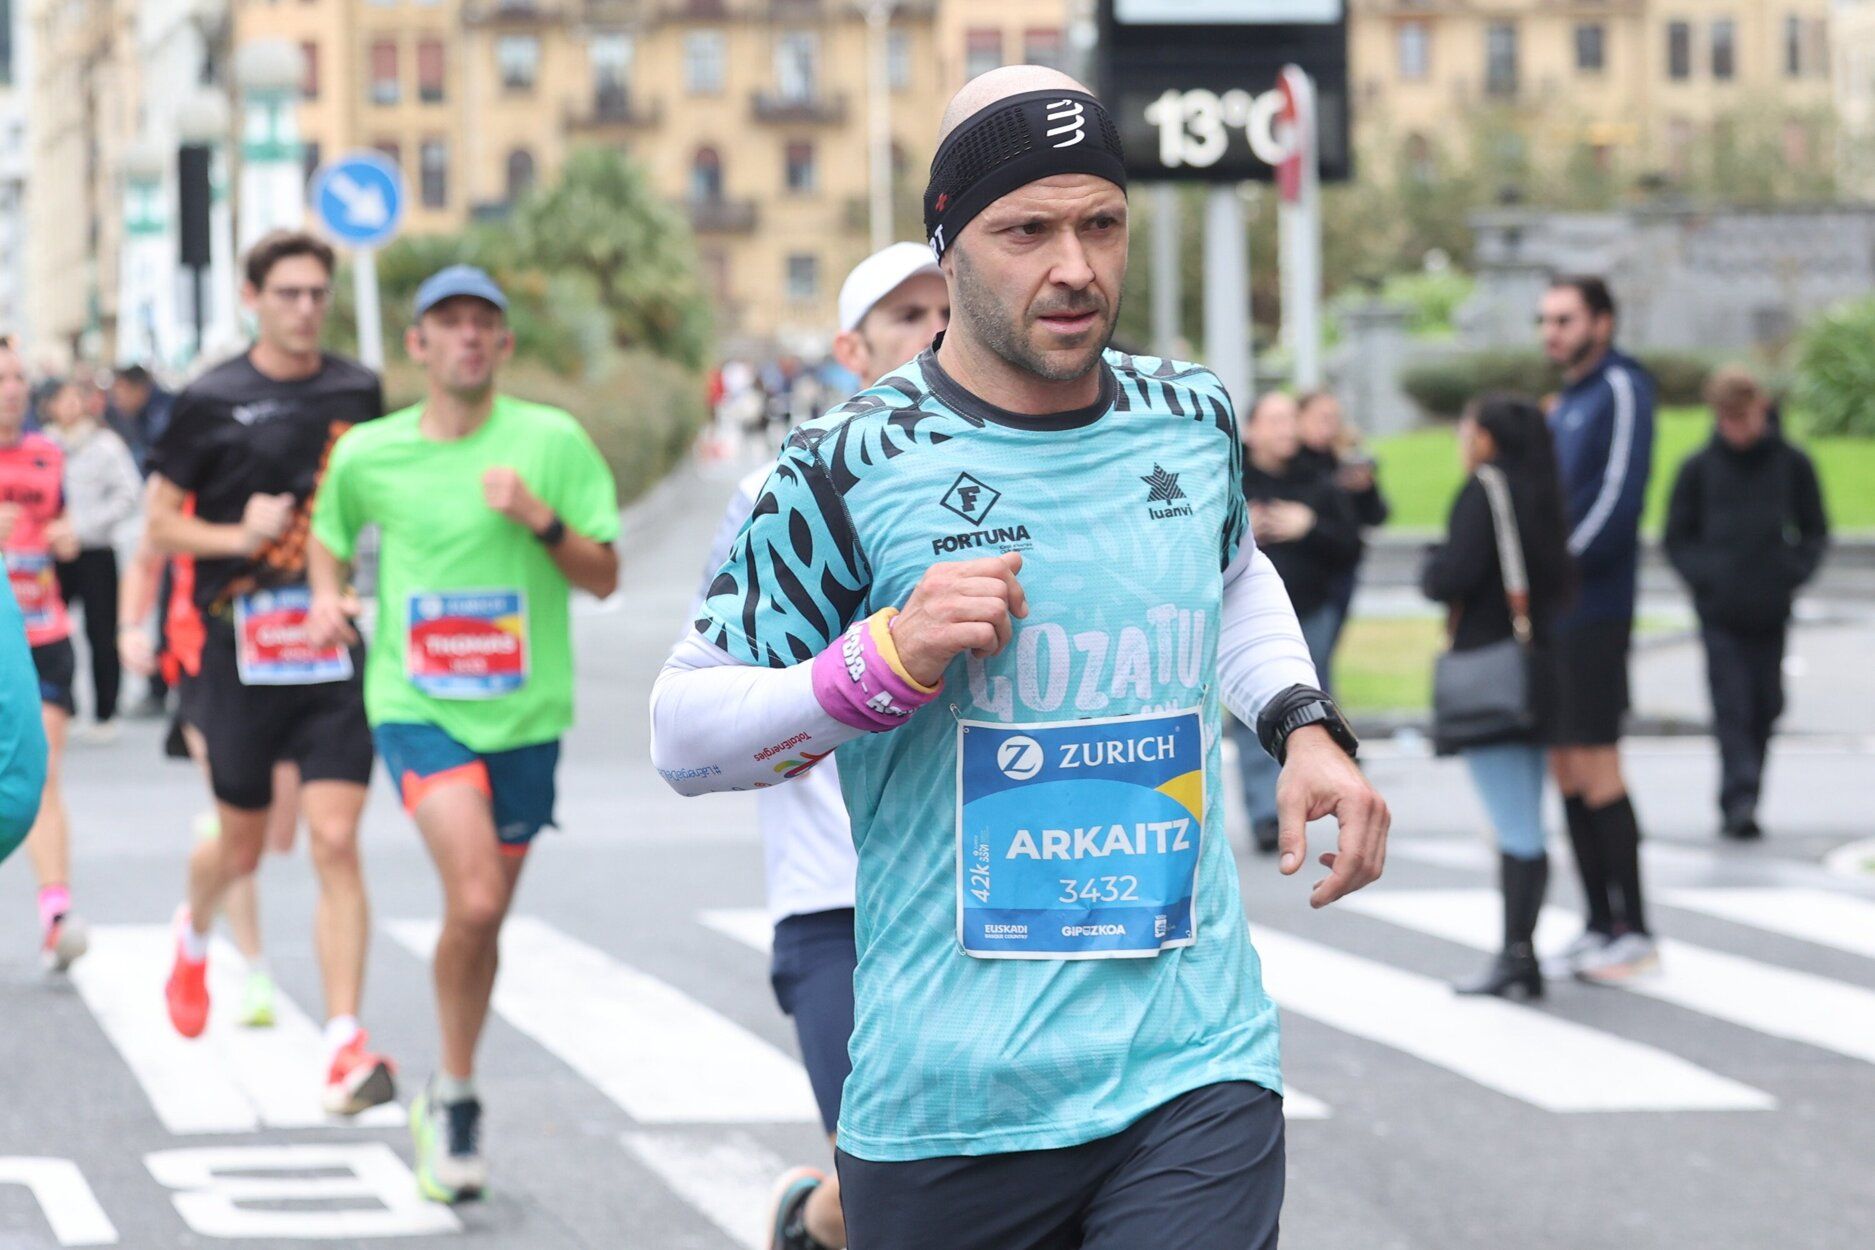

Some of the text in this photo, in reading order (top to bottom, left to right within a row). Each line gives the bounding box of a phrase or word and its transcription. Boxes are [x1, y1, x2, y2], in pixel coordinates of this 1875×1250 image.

[1148, 503, 1193, 520] luanvi
[931, 525, 1031, 556] FORTUNA
[753, 730, 812, 762] TotalEnergies
[1058, 735, 1175, 769] ZURICH
[1005, 817, 1190, 860] ARKAITZ
[969, 862, 990, 903] 42k
[1058, 875, 1139, 903] 3432
[984, 924, 1028, 934] EUSKADI
[1061, 924, 1126, 937] GIPUZKOA
